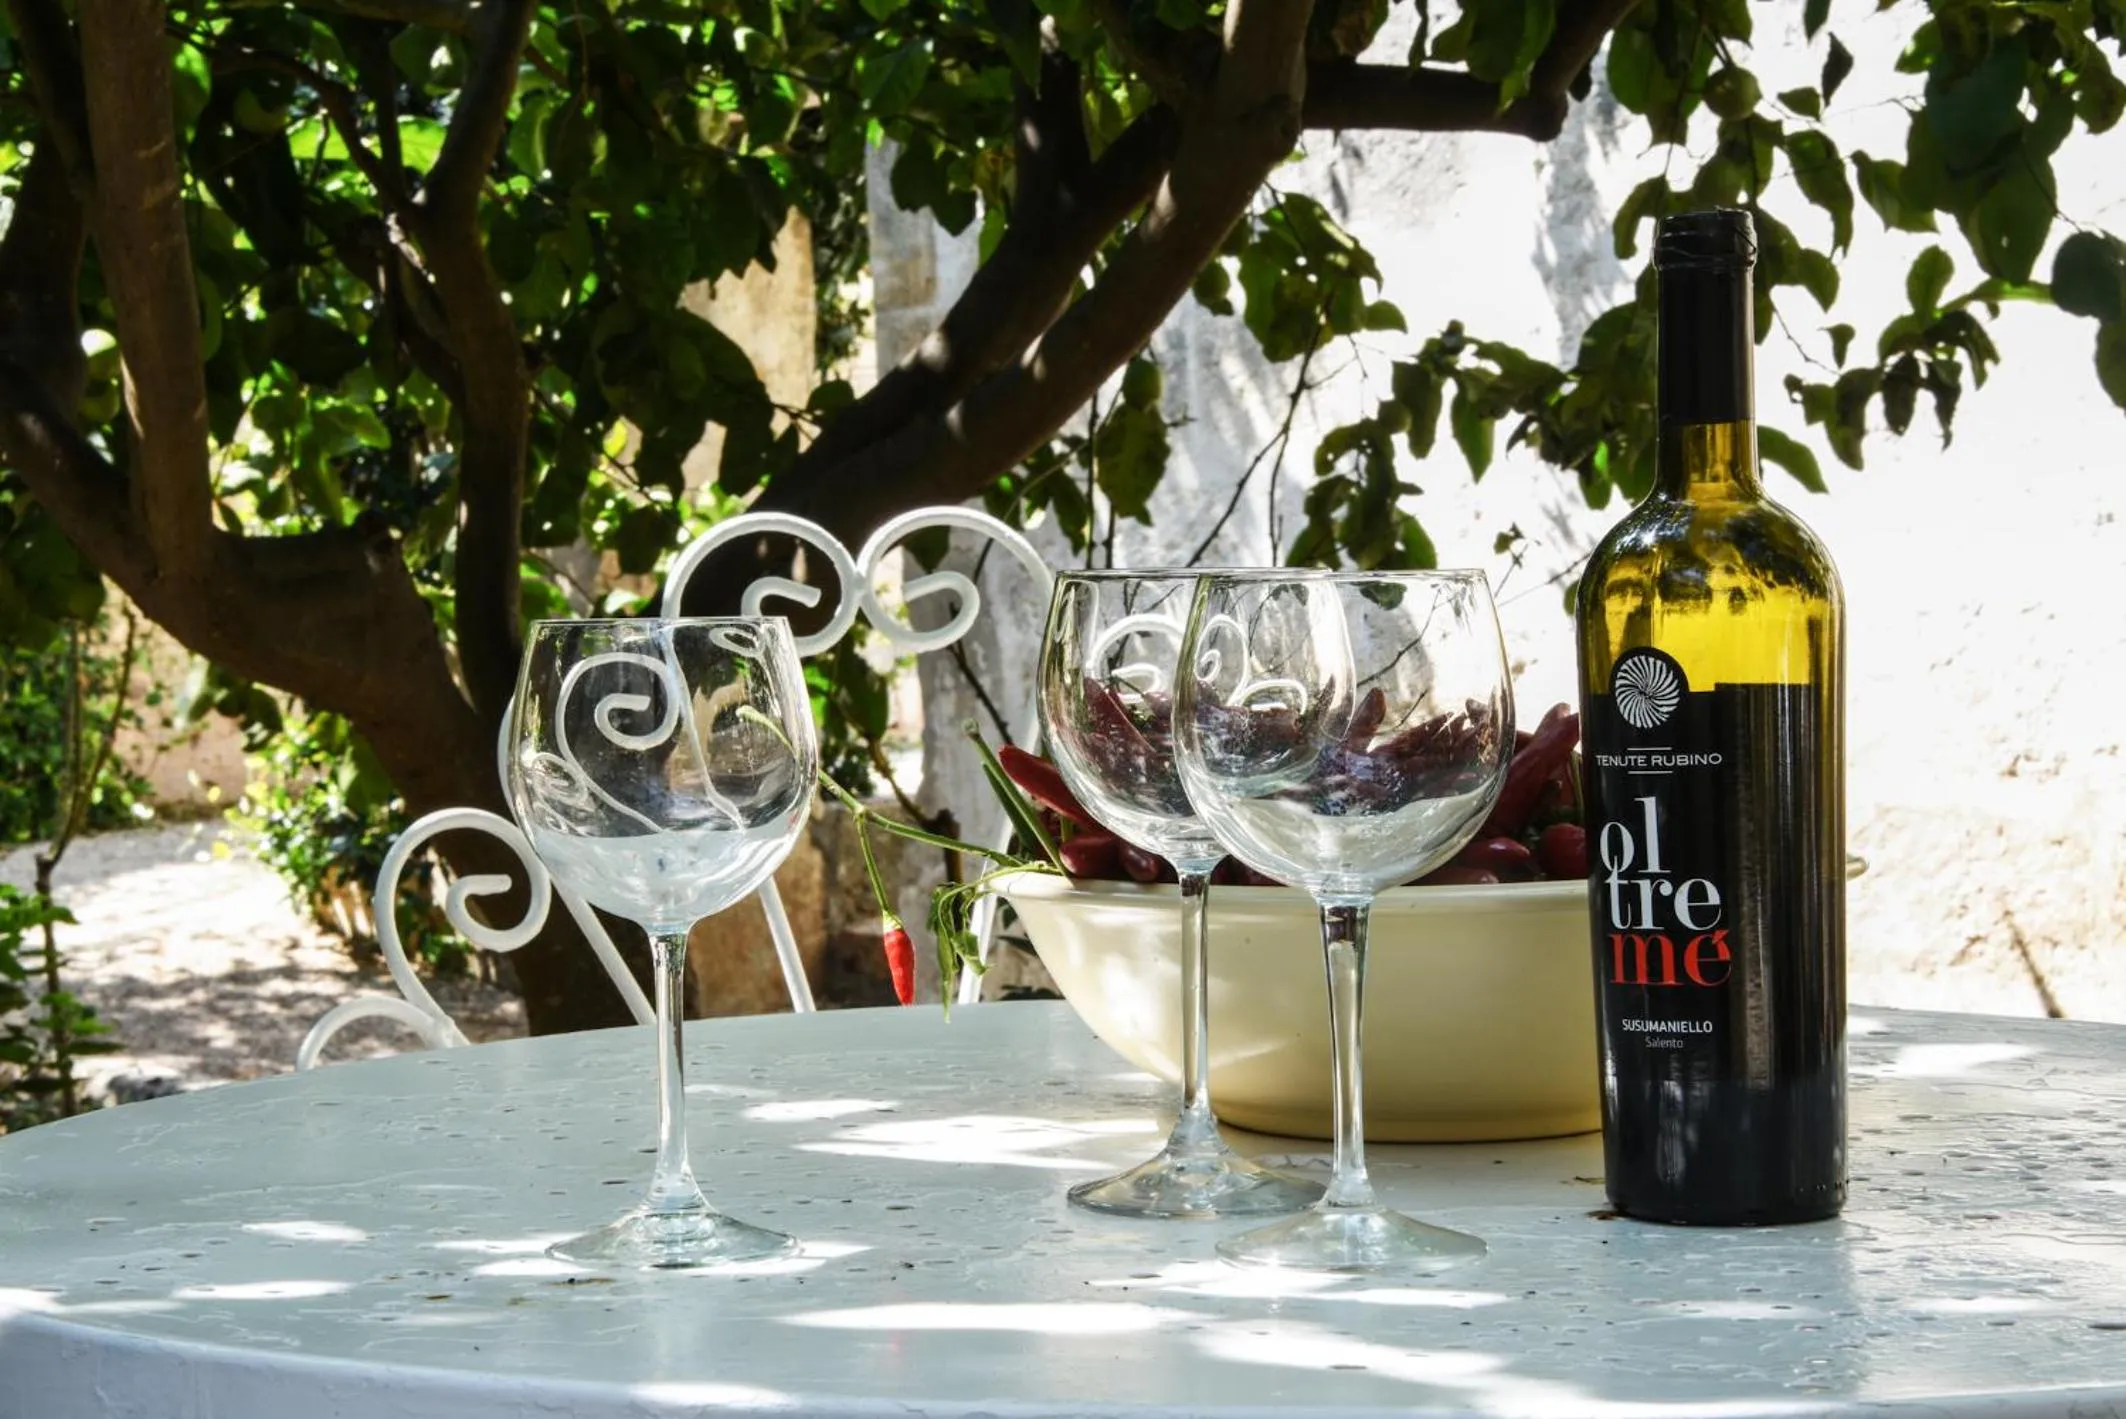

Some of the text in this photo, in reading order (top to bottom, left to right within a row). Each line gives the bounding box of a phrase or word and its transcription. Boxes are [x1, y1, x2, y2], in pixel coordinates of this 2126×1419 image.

[1596, 753, 1722, 767] TENUTE RUBINO
[1600, 796, 1671, 873] ol
[1604, 855, 1721, 930] tre
[1622, 1018, 1713, 1033] SUSUMANIELLO
[1645, 1036, 1683, 1049] Salento
